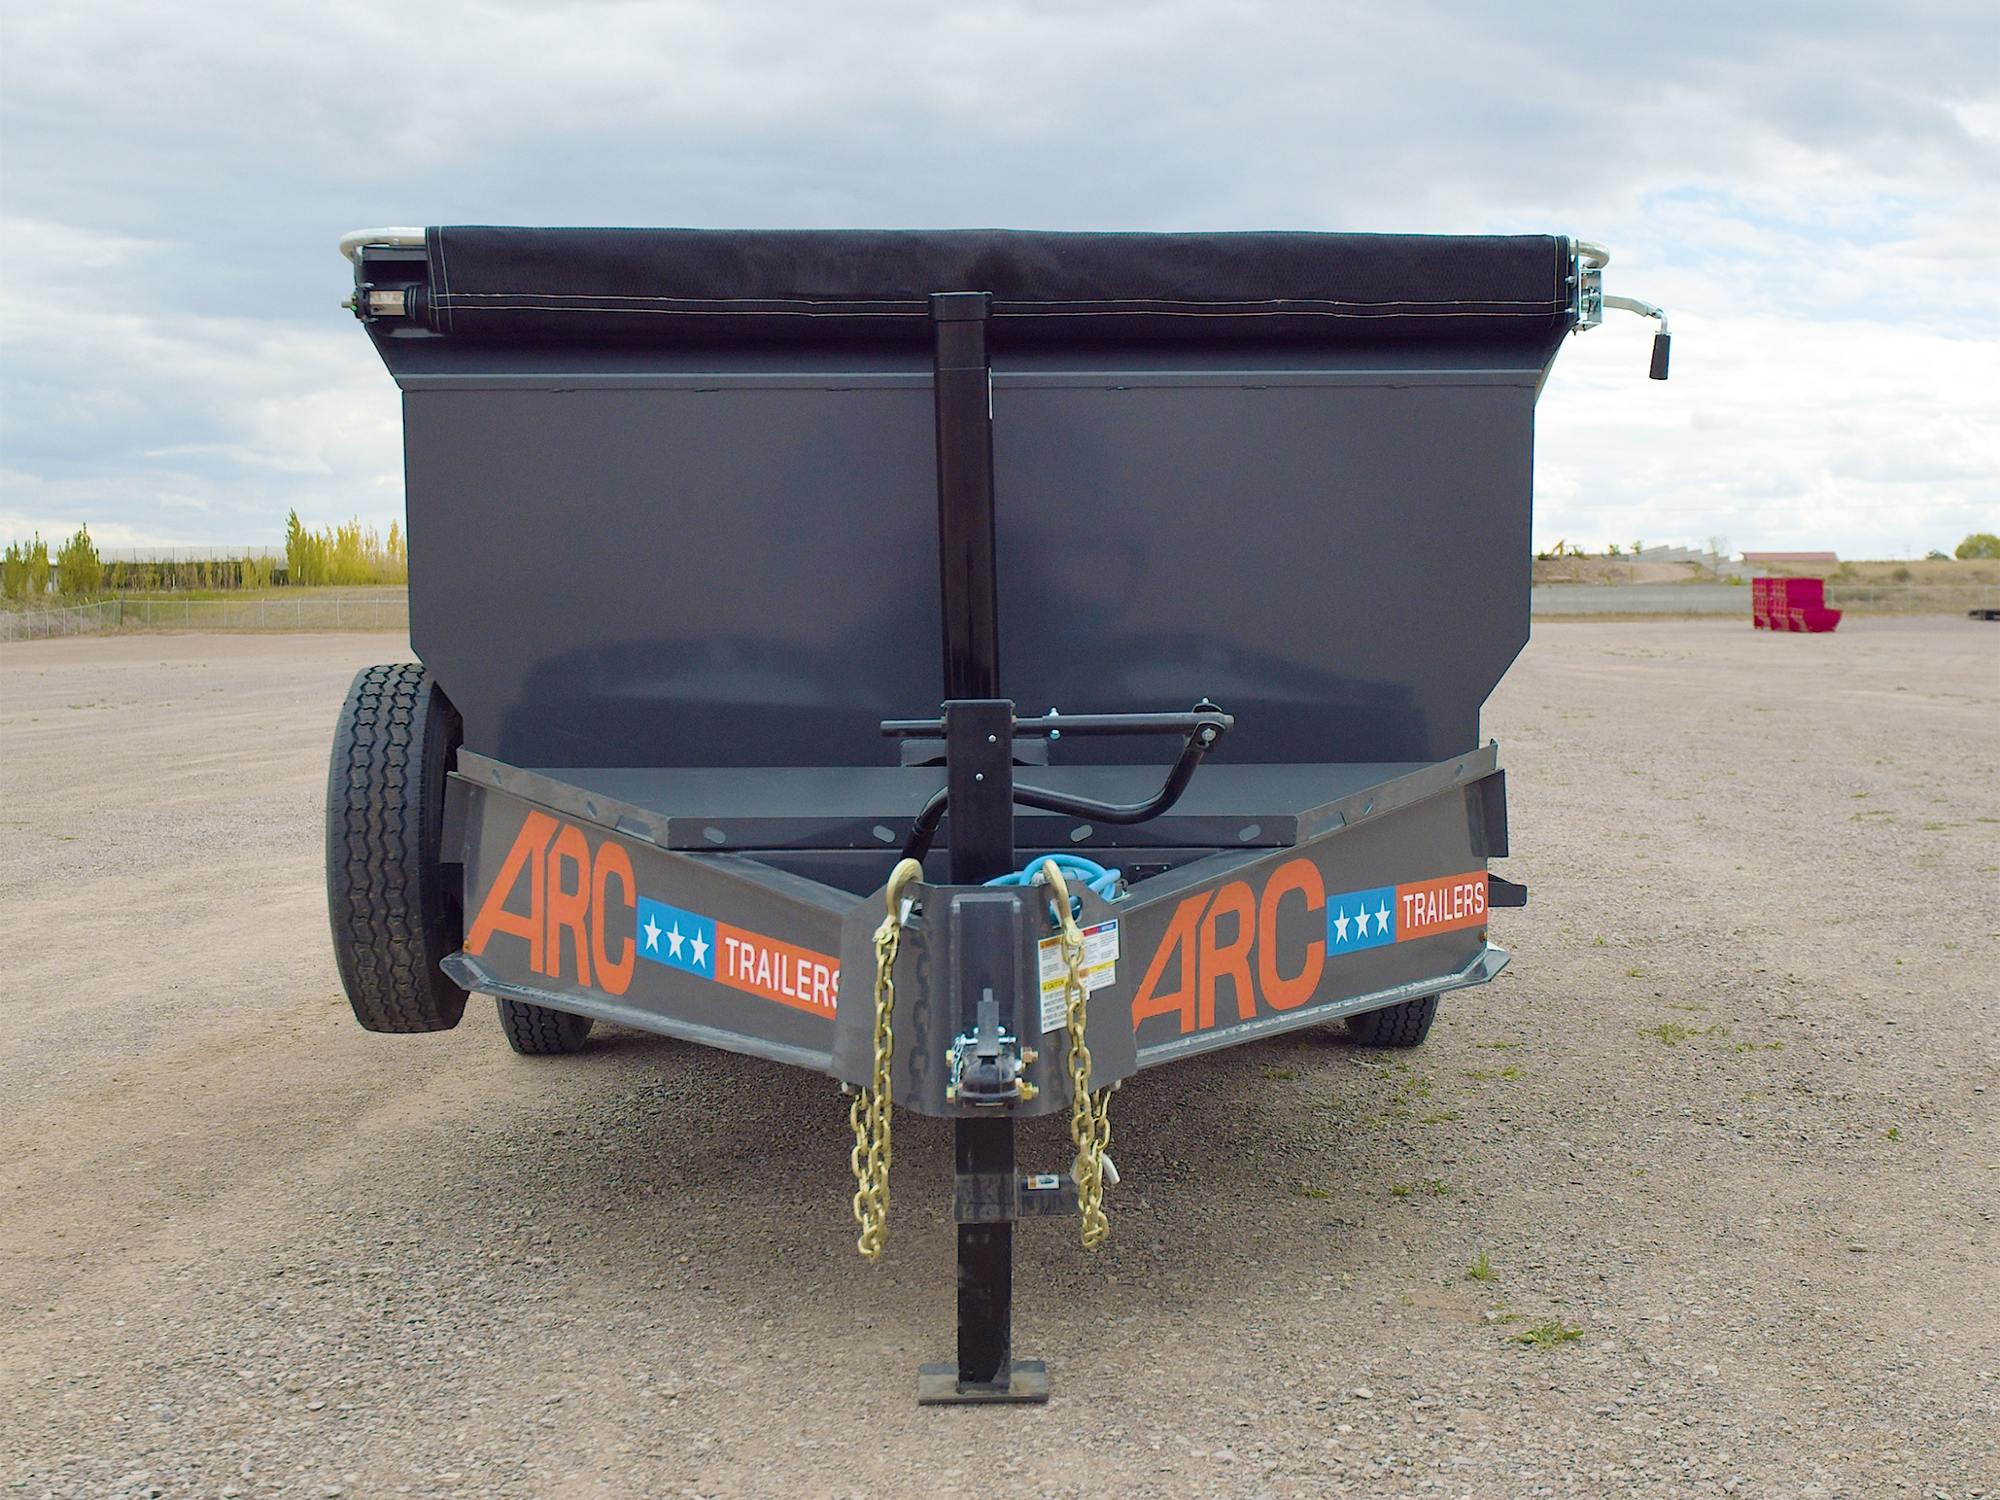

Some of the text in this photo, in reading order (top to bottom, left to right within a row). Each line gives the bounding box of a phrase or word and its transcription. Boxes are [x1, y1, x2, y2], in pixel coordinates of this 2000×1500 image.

[464, 809, 636, 996] ARC
[1131, 857, 1485, 1034] ARC TRAILERS
